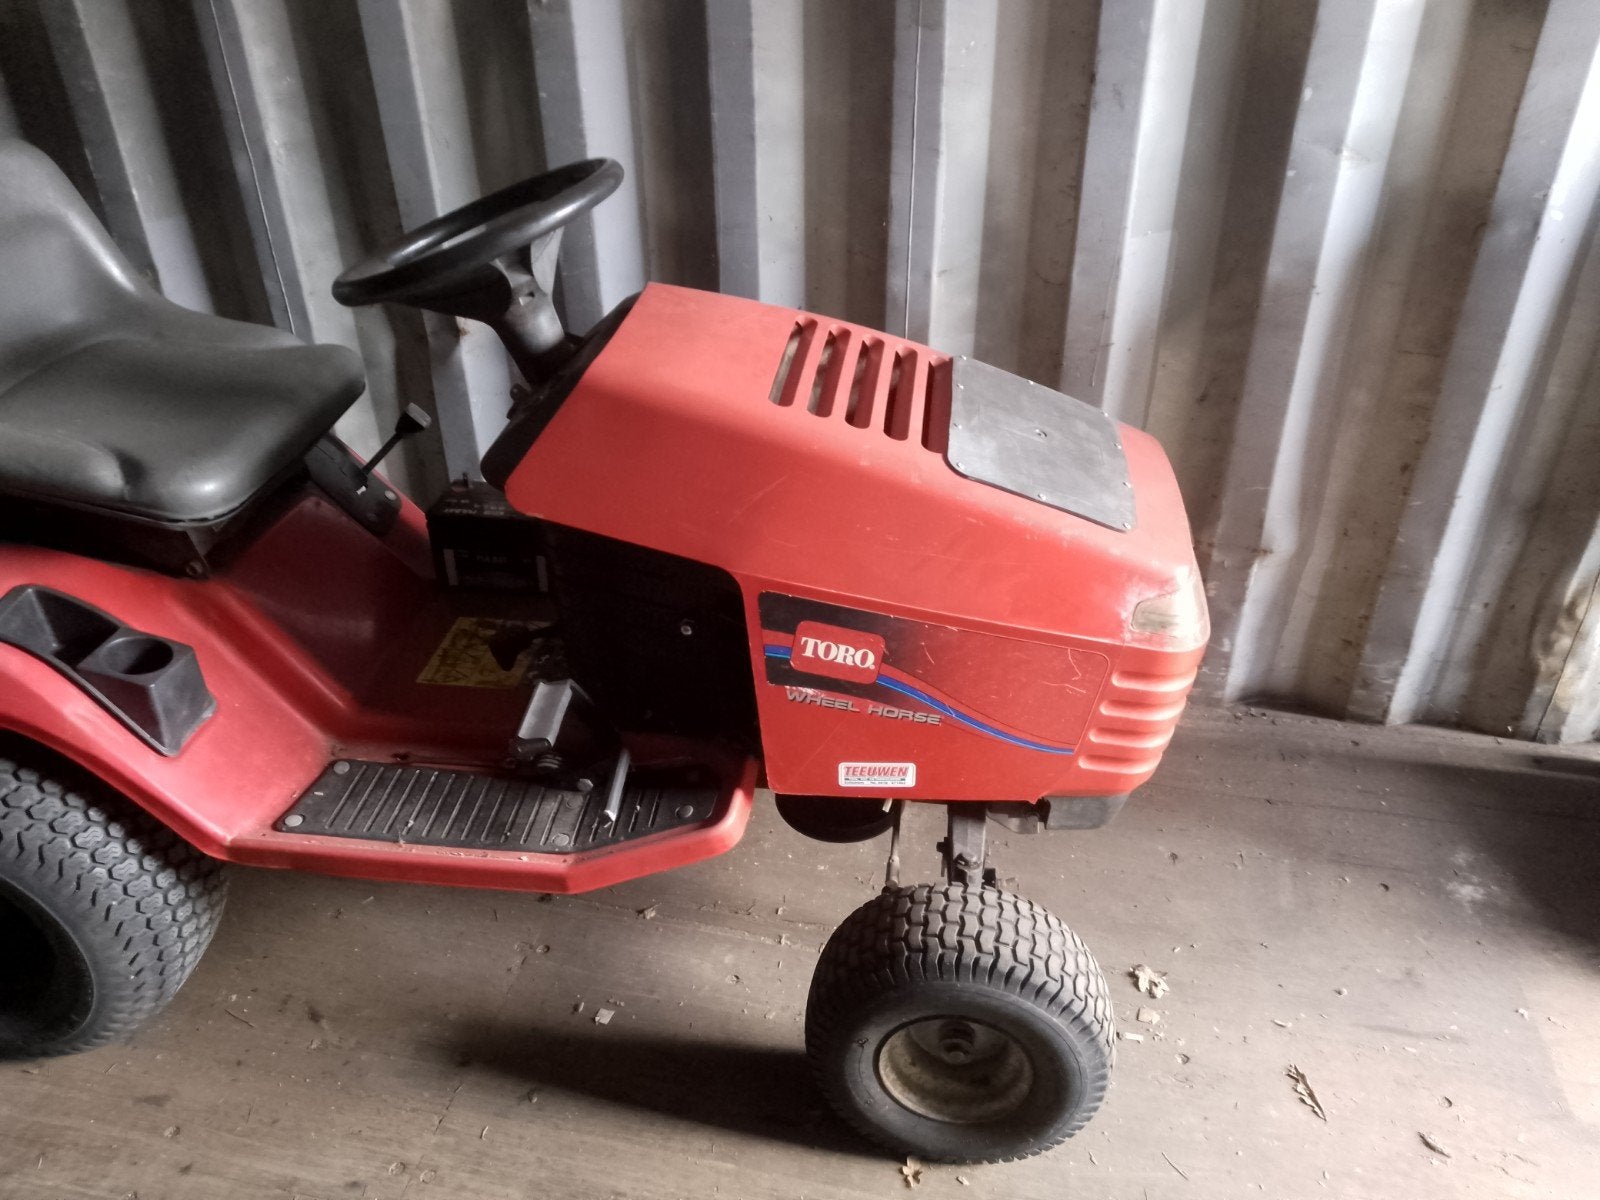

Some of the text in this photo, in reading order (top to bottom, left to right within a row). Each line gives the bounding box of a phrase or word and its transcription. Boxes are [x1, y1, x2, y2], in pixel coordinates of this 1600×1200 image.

[785, 688, 941, 725] WHEEL HORSE
[844, 766, 909, 777] TEEUWEN
